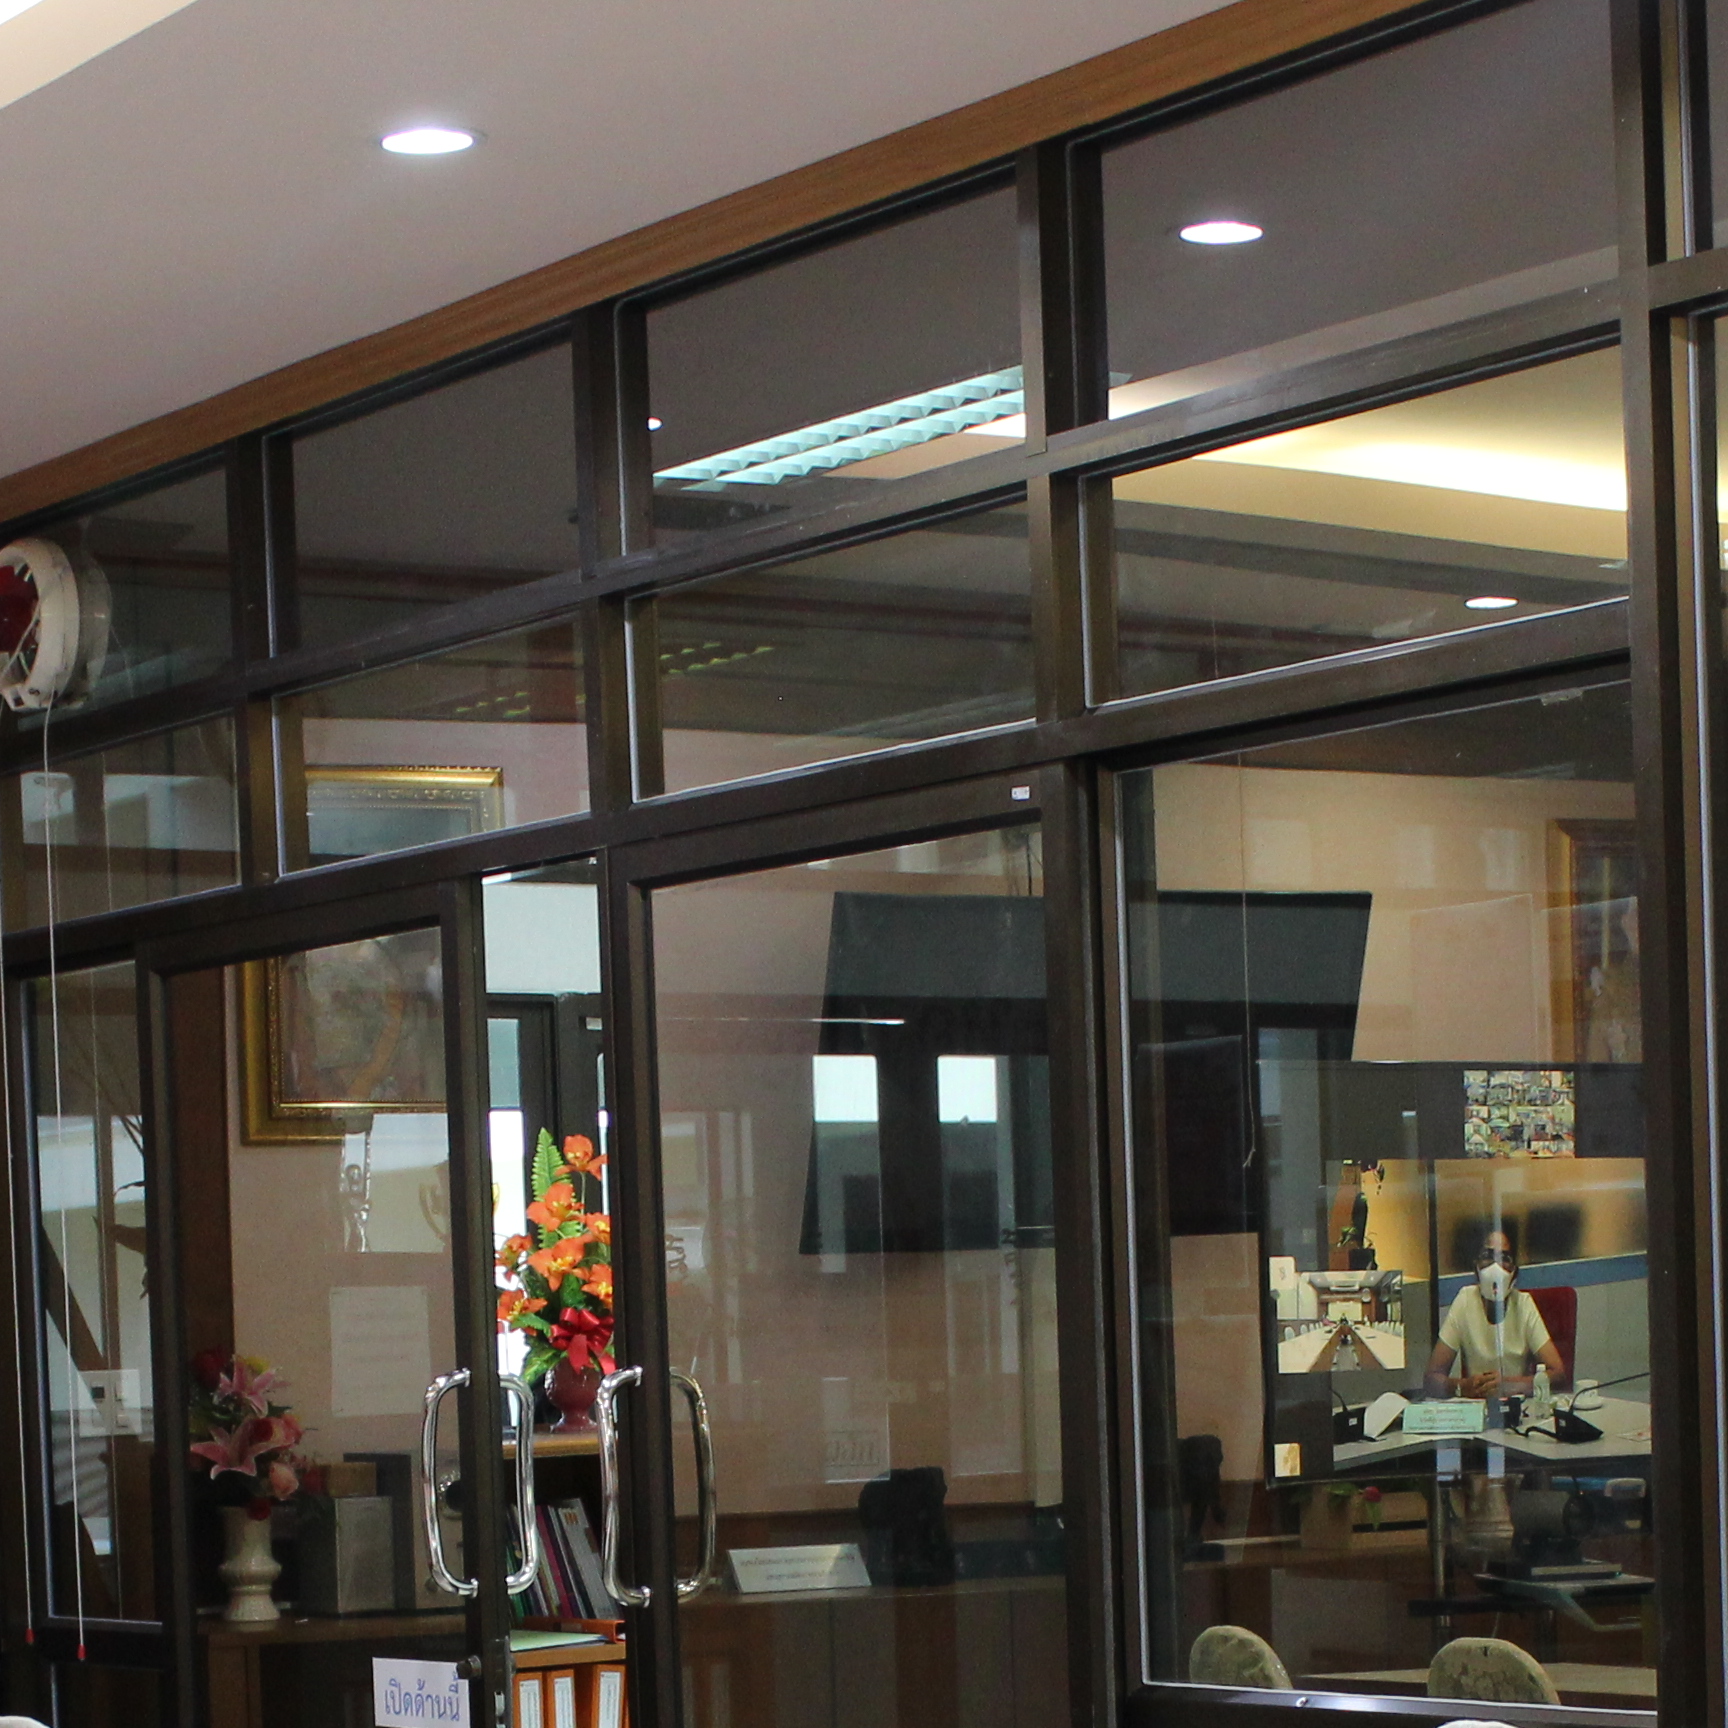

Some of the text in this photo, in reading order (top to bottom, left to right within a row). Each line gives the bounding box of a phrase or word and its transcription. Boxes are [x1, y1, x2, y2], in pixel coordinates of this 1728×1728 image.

[384, 1670, 460, 1721] เปิดด้านนี้
